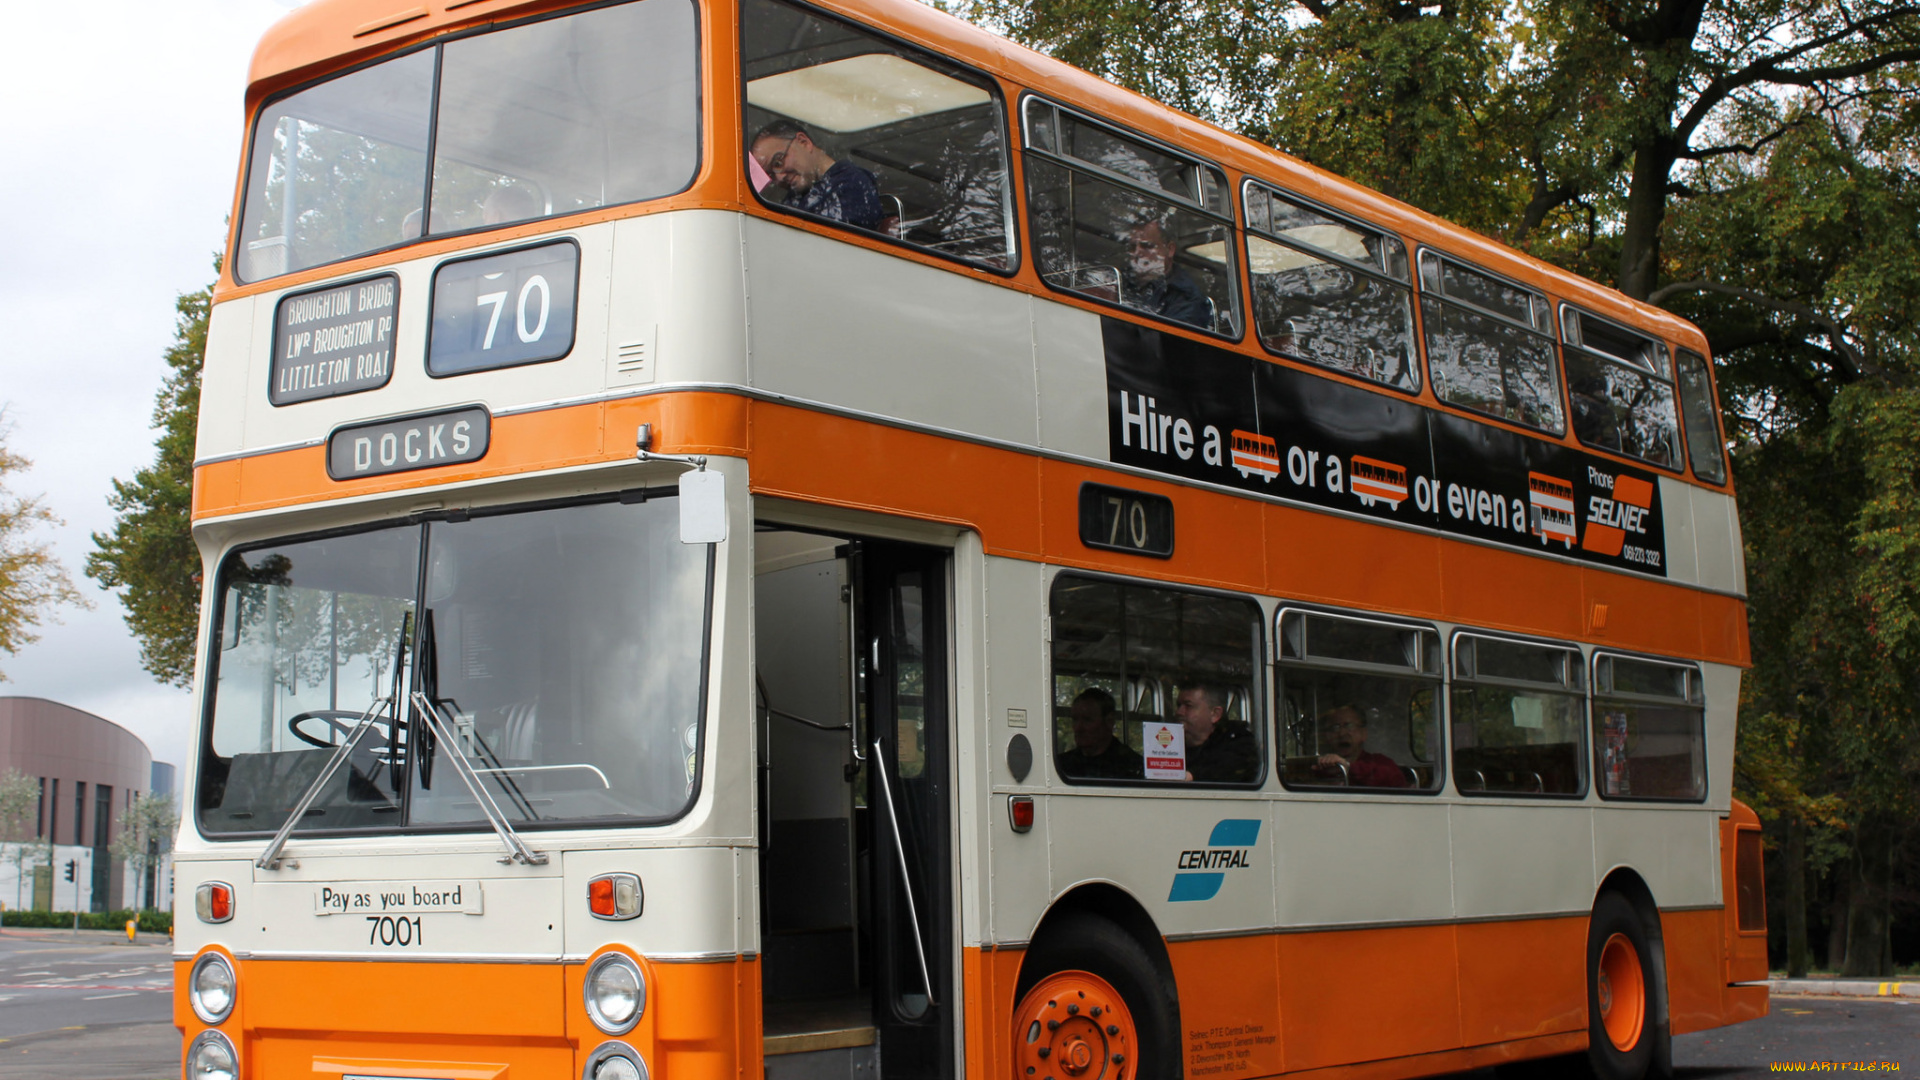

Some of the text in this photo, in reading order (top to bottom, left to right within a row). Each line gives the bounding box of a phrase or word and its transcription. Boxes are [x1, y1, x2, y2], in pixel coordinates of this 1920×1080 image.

[288, 282, 394, 325] BROUGHTON BRIDG
[477, 275, 550, 350] 70
[313, 319, 374, 355] BROUGHTON
[279, 357, 351, 393] LITTLETON
[354, 420, 470, 472] DOCKS
[1120, 390, 1527, 534] Hire a or a or even a
[1588, 465, 1614, 490] Phone
[1108, 497, 1147, 548] 70
[1586, 495, 1650, 534] SELNEC
[1178, 850, 1250, 869] CENTRAL
[322, 885, 461, 912] Pay as you board
[366, 916, 422, 946] 7001
[1210, 1027, 1224, 1037] PTE
